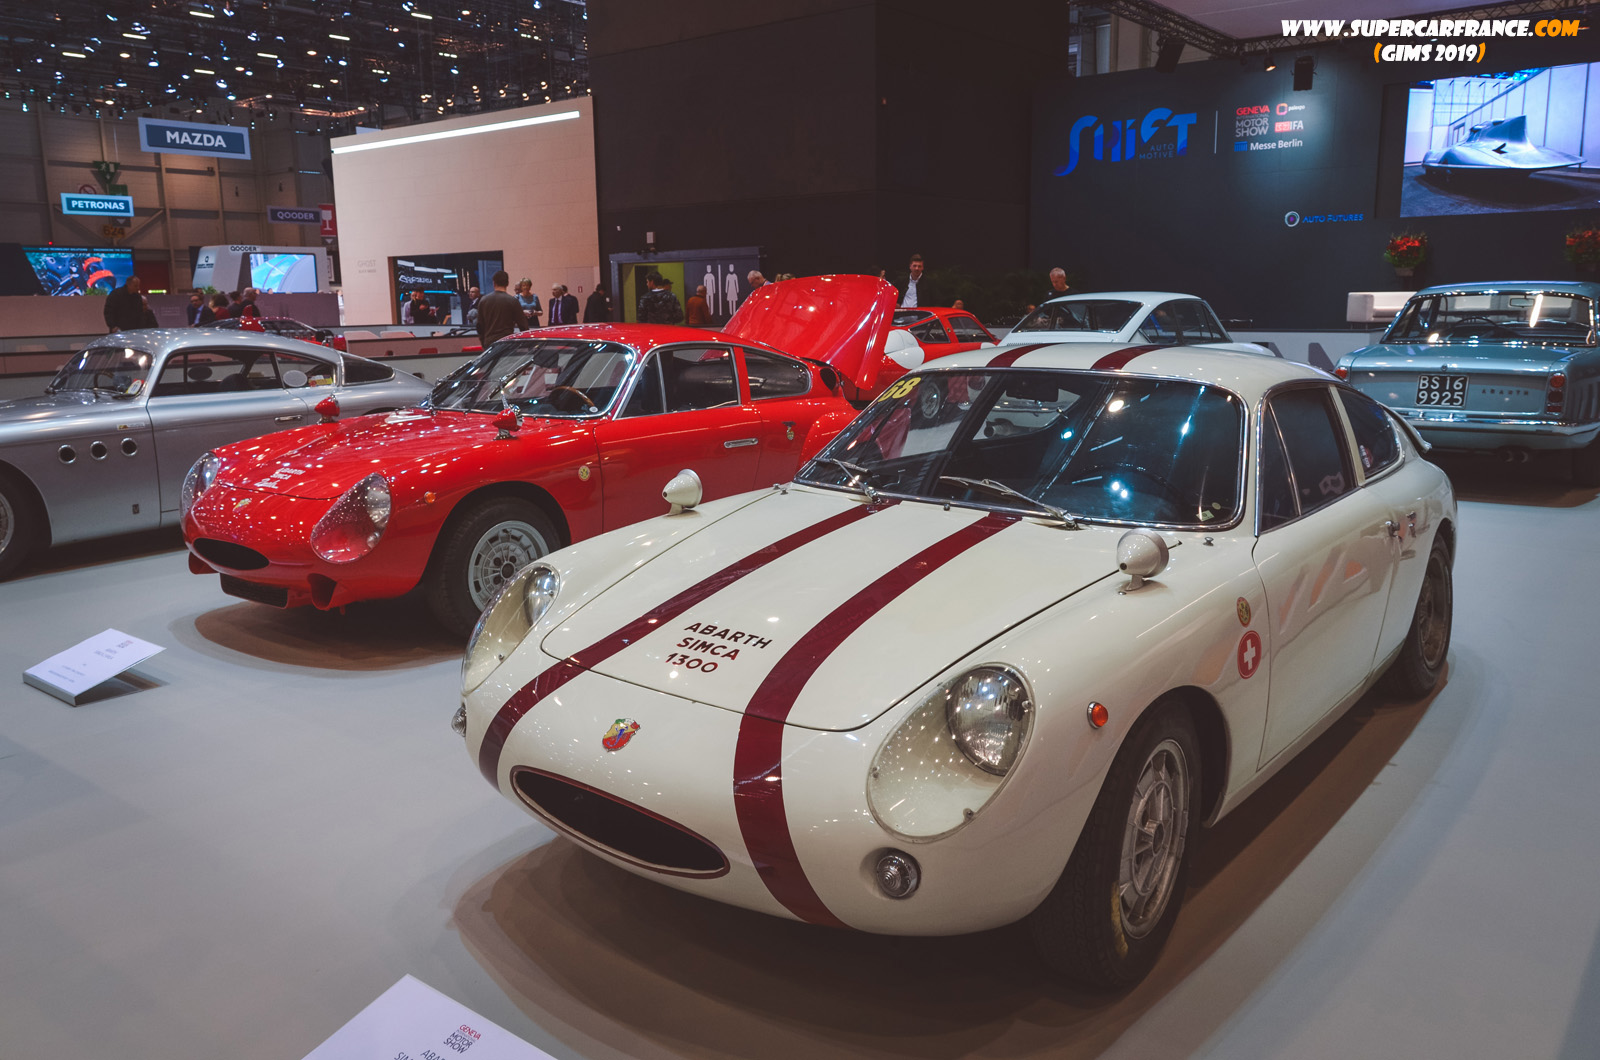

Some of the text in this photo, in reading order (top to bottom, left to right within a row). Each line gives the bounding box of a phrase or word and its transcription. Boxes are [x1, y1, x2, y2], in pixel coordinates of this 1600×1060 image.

[1236, 105, 1270, 116] GENEVA
[1235, 118, 1269, 128] MOTOR
[1290, 120, 1304, 130] IFA
[1235, 126, 1269, 137] SHOW
[166, 130, 227, 148] MAZDA
[1250, 139, 1303, 150] Messe Berlin
[1150, 143, 1175, 151] AUTO
[1139, 151, 1174, 160] MOTIVE
[71, 200, 125, 210] PETRONAS
[277, 211, 315, 220] QOODER
[1302, 213, 1364, 223] AUTO FUTURES
[1419, 376, 1465, 390] BS 16
[877, 377, 922, 402] 68
[1418, 391, 1464, 406] 9925
[683, 622, 773, 649] ABARTH
[676, 637, 741, 661] SIMCA
[665, 652, 719, 673] 1300
[459, 1024, 482, 1040] GENEVA
[443, 1037, 468, 1054] SHOW
[449, 1032, 473, 1049] MOTOR
